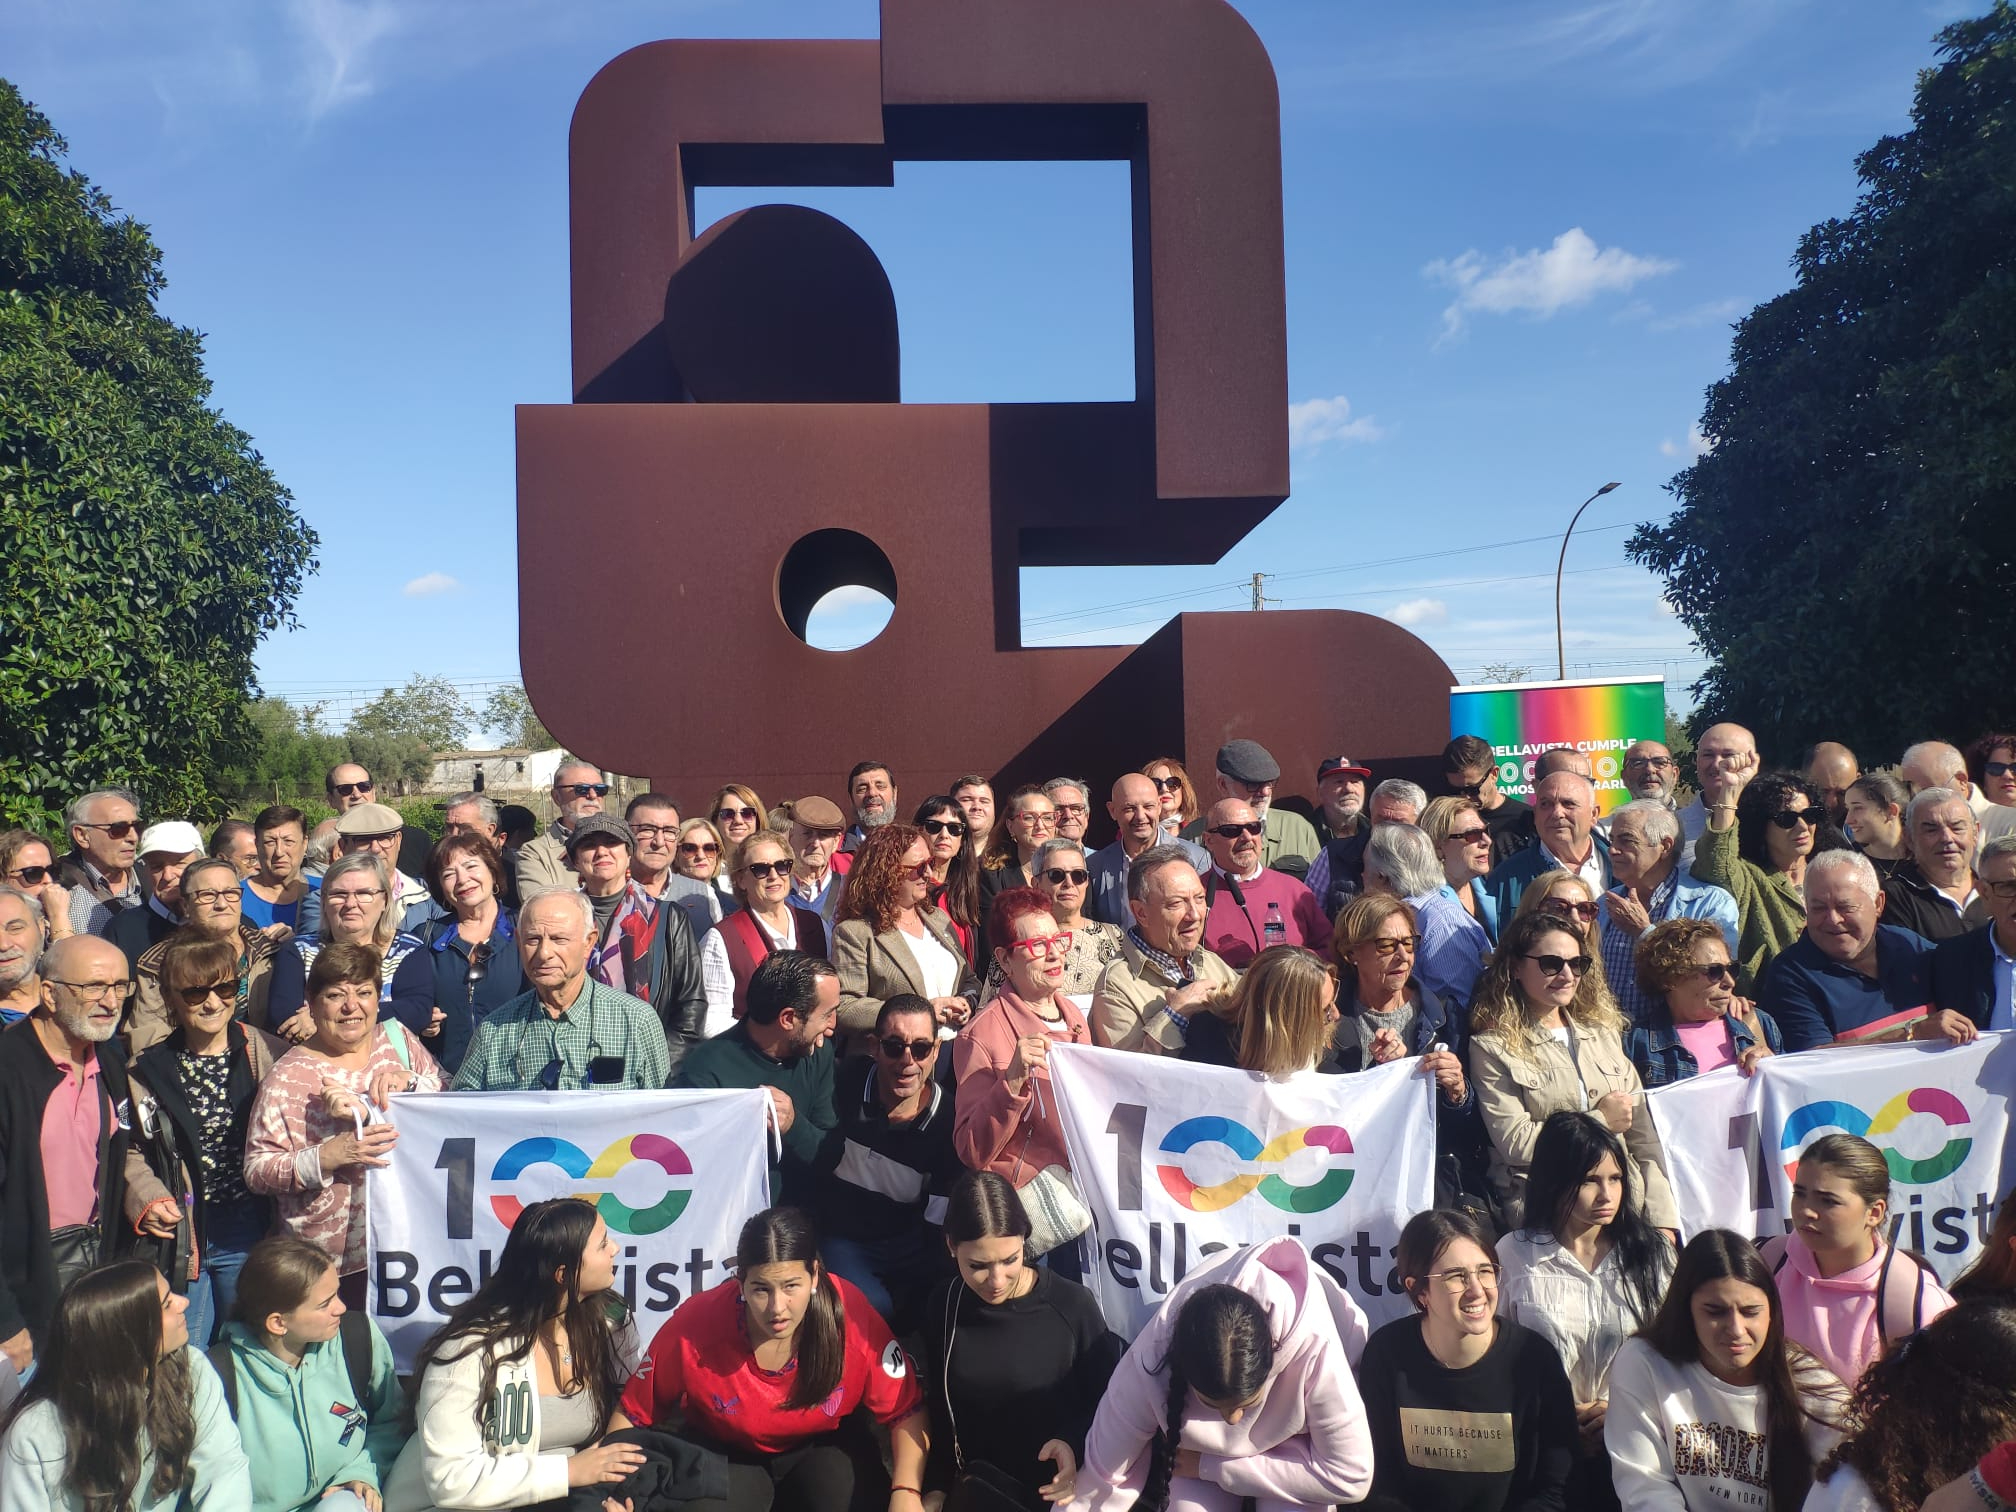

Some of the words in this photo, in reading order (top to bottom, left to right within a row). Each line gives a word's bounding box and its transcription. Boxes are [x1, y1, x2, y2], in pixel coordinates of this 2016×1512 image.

[1577, 739, 1637, 752] CUMPLE
[1498, 784, 1535, 796] AMOS
[1105, 1102, 1356, 1214] 100
[434, 1133, 694, 1240] 100
[375, 1245, 739, 1318] Belist
[1410, 1424, 1418, 1435] IT
[1423, 1425, 1455, 1437] HURTS
[1458, 1428, 1502, 1440] BECAUSE
[1411, 1445, 1419, 1455] IT
[1424, 1446, 1469, 1459] MATTERS
[1674, 1421, 1768, 1489] BROOKL
[1708, 1484, 1731, 1500] NEW
[1737, 1492, 1764, 1507] YORK
